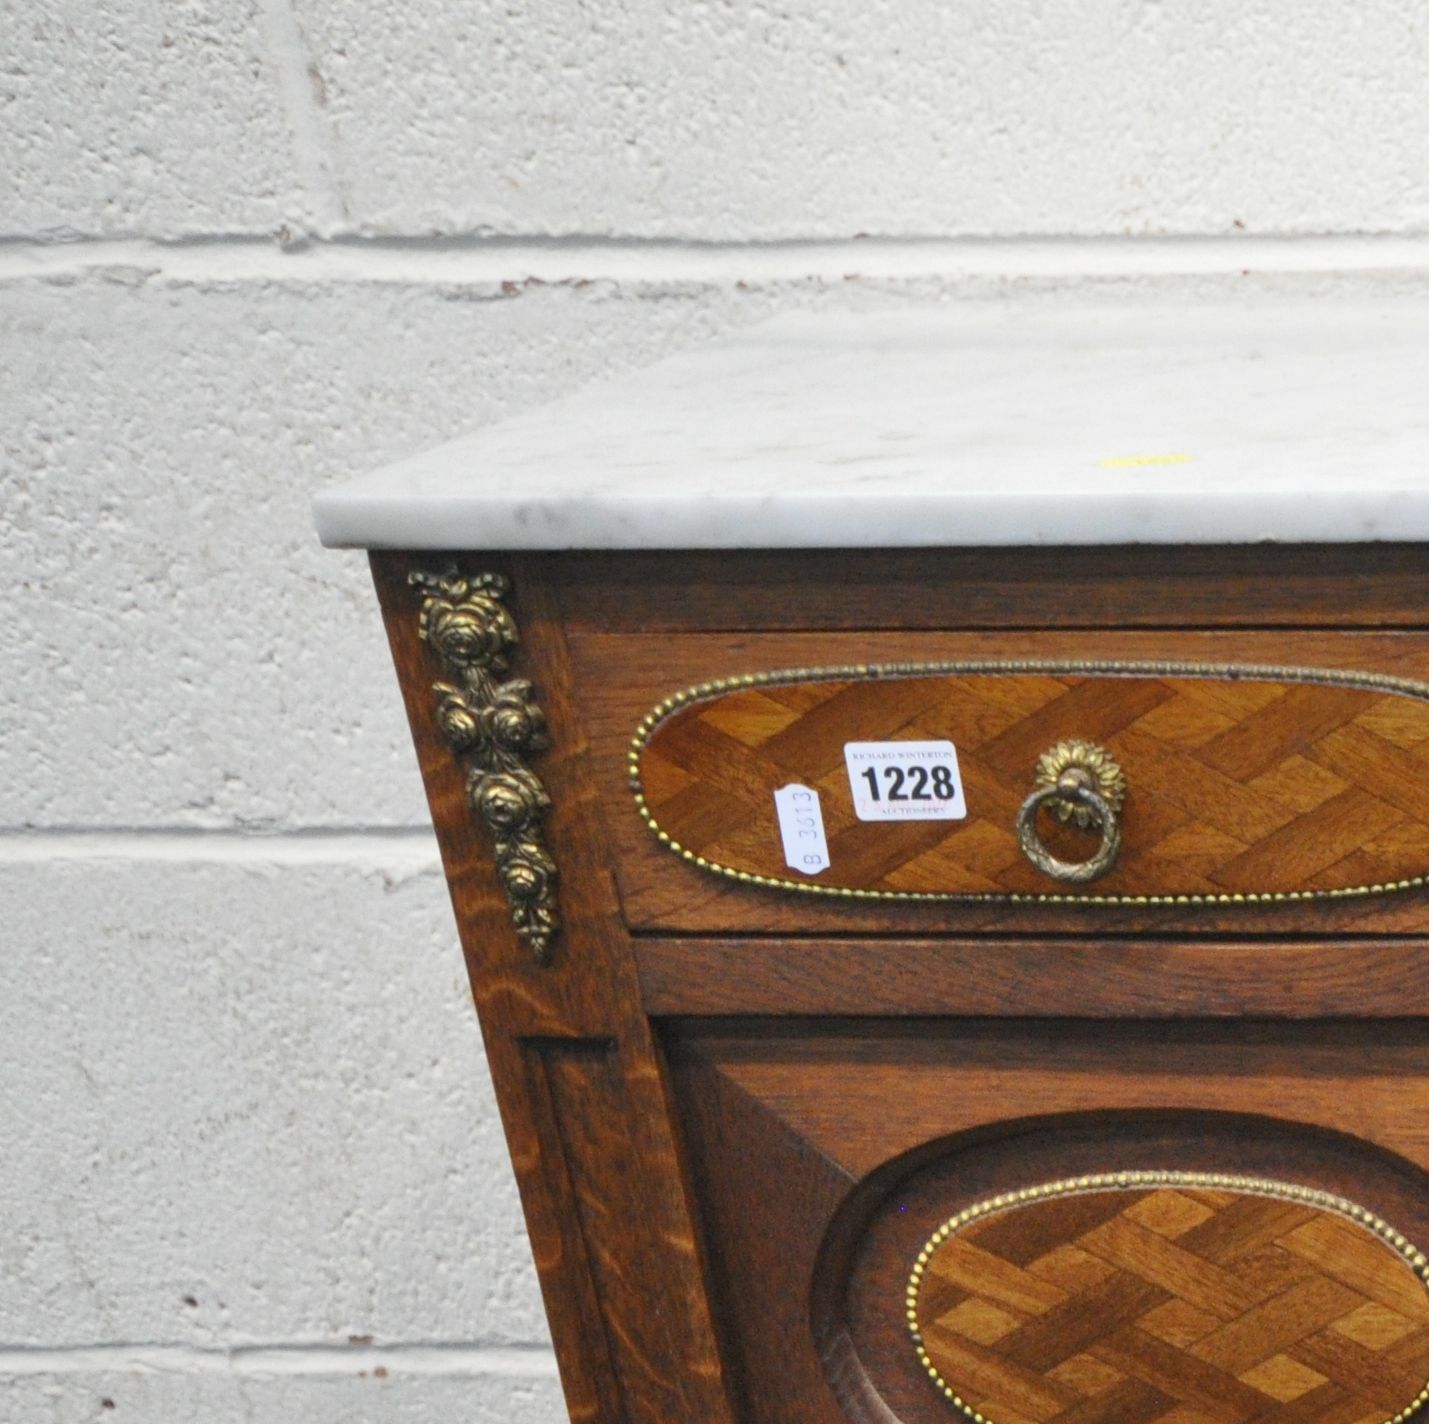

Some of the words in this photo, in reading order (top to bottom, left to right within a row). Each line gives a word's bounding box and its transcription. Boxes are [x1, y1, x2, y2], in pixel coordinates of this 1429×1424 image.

[852, 751, 896, 760] RICHARD
[898, 751, 953, 759] WINTERTON
[861, 765, 955, 802] 1228
[792, 792, 818, 839] 3613
[803, 854, 822, 865] B
